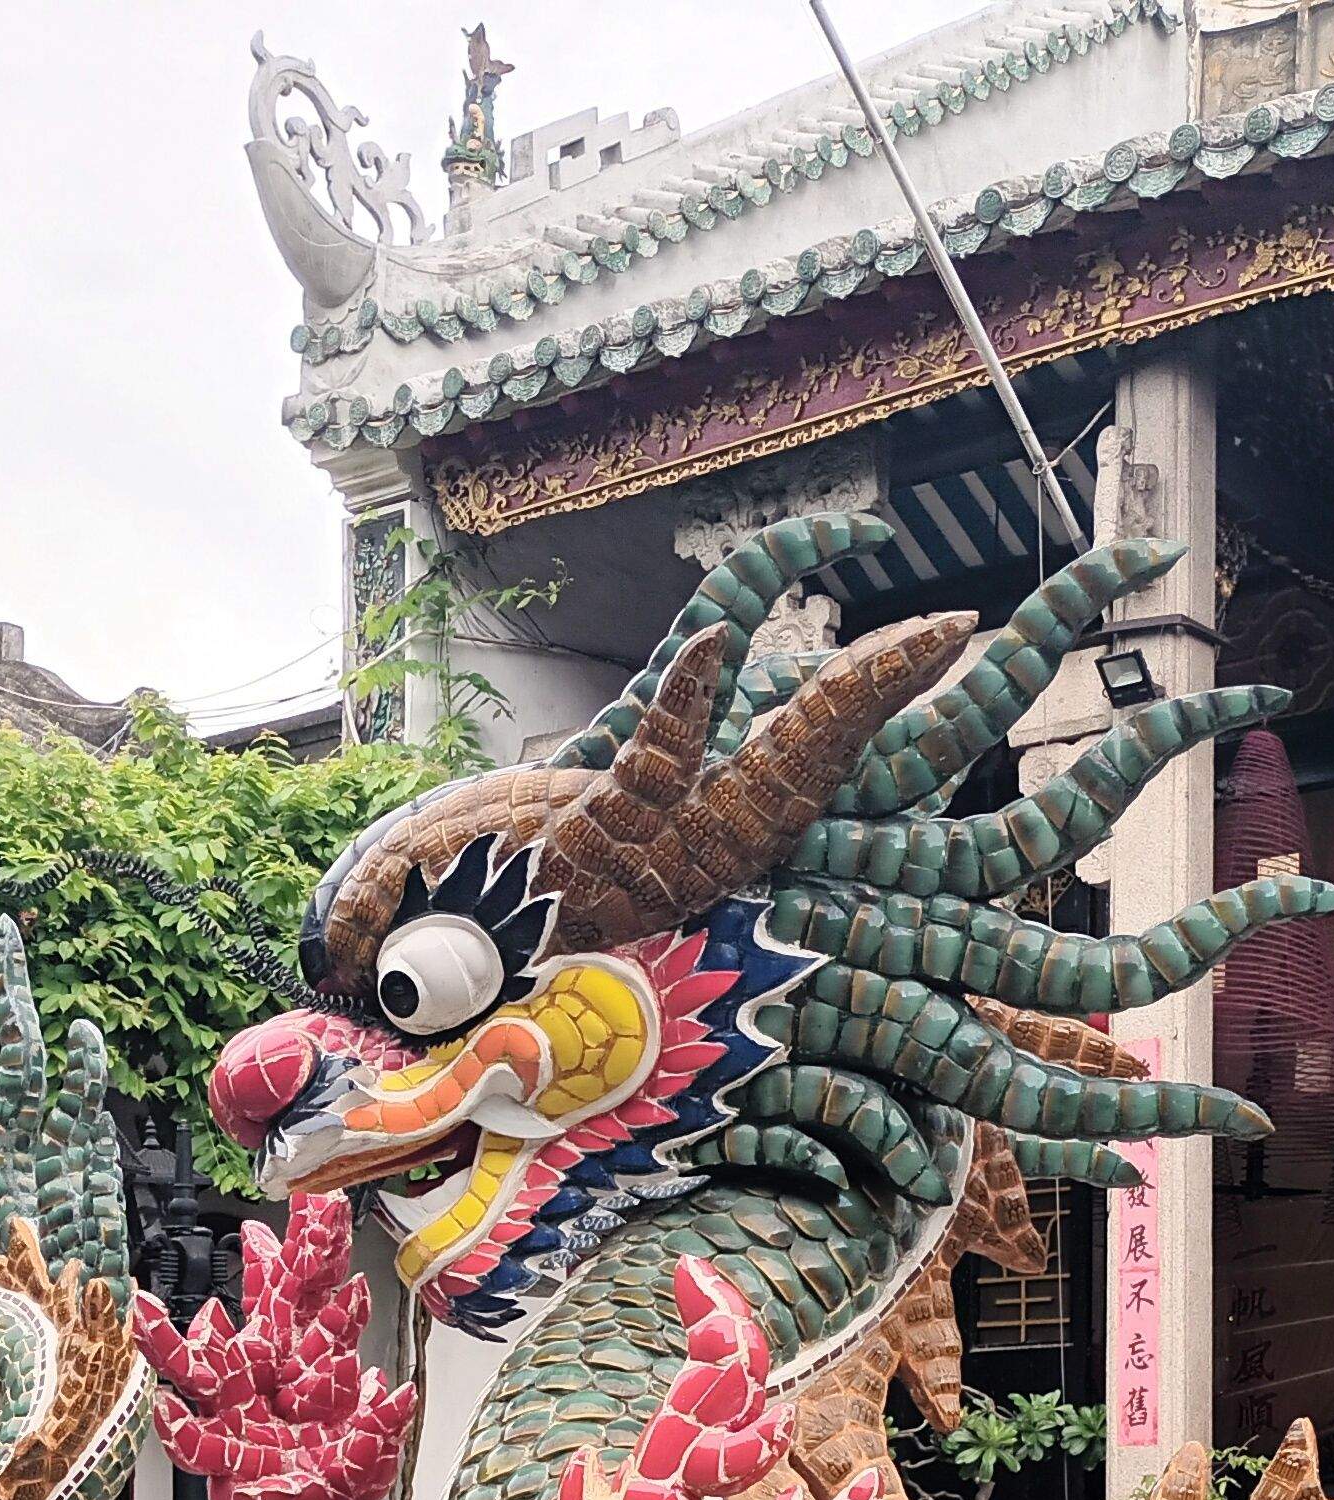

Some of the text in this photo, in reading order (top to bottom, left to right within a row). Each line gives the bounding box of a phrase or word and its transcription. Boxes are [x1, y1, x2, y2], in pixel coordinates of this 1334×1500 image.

[1123, 1057, 1156, 1427] 發展不忘舊
[1230, 1243, 1278, 1432] 一帆風順
